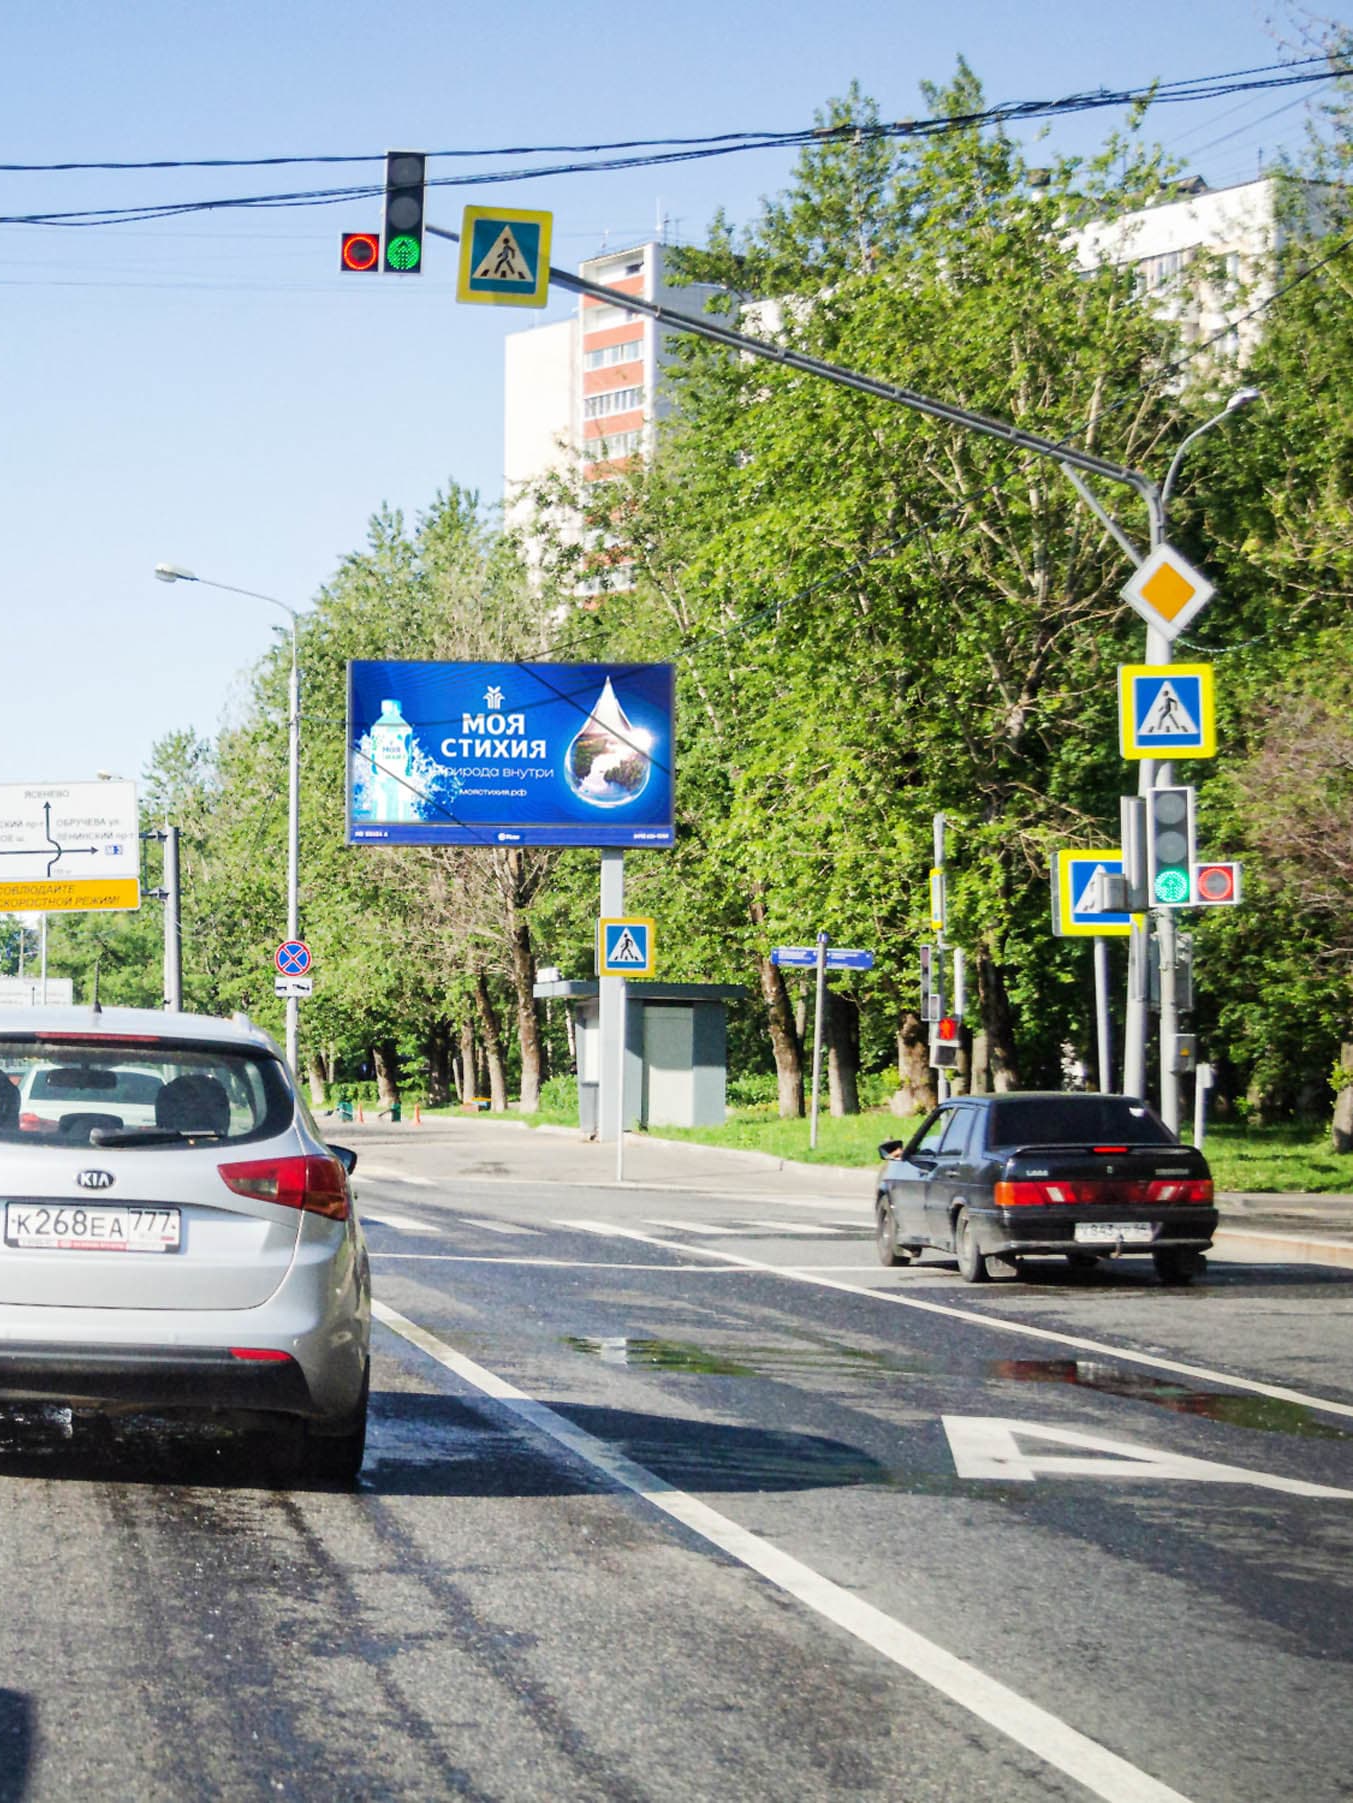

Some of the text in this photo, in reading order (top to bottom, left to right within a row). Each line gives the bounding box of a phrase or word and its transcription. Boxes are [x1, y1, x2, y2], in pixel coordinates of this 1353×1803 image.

[462, 713, 525, 735] МОЯ
[440, 738, 547, 759] СТИХИЯ
[502, 768, 555, 780] внутри
[80, 1172, 110, 1187] KIA
[16, 1208, 171, 1238] К268ЕА 777
